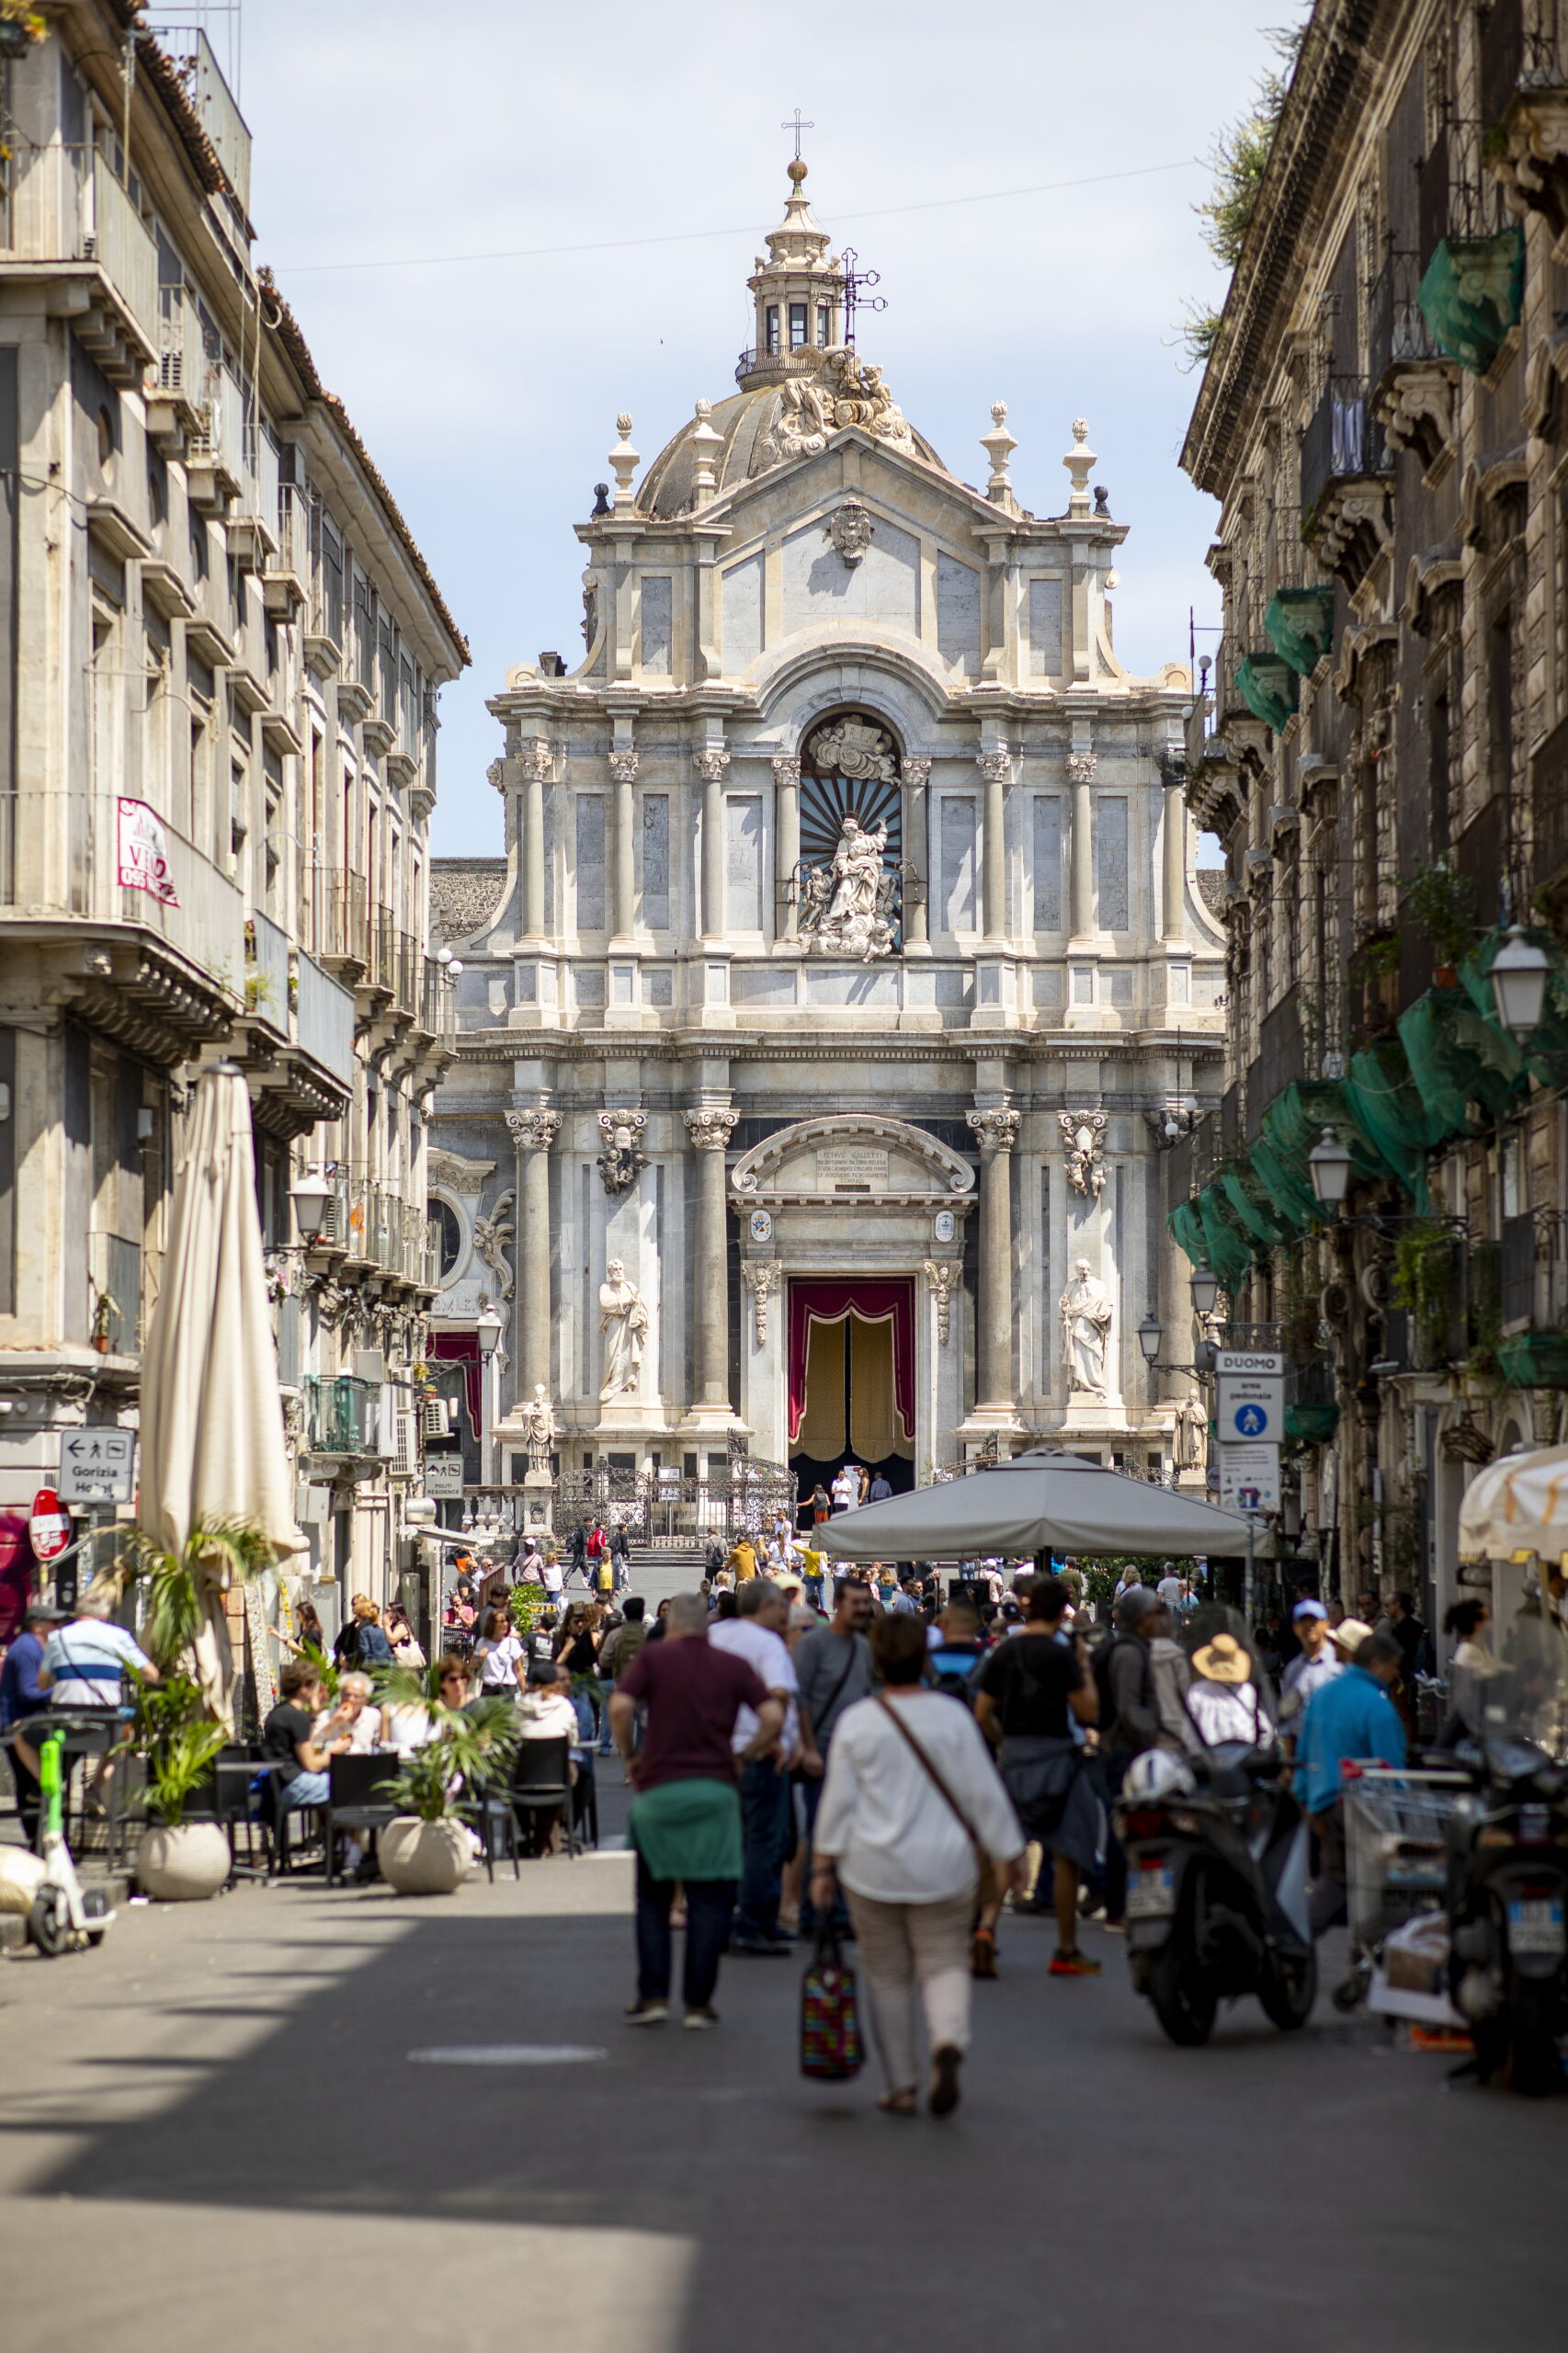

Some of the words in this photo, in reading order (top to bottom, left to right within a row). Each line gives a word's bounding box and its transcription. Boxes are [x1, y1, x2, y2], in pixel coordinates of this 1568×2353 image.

[1223, 1357, 1276, 1370] DUOMO
[1230, 1392, 1272, 1400] pedonale
[72, 1465, 119, 1477] Gorizia
[75, 1482, 113, 1494] Hol
